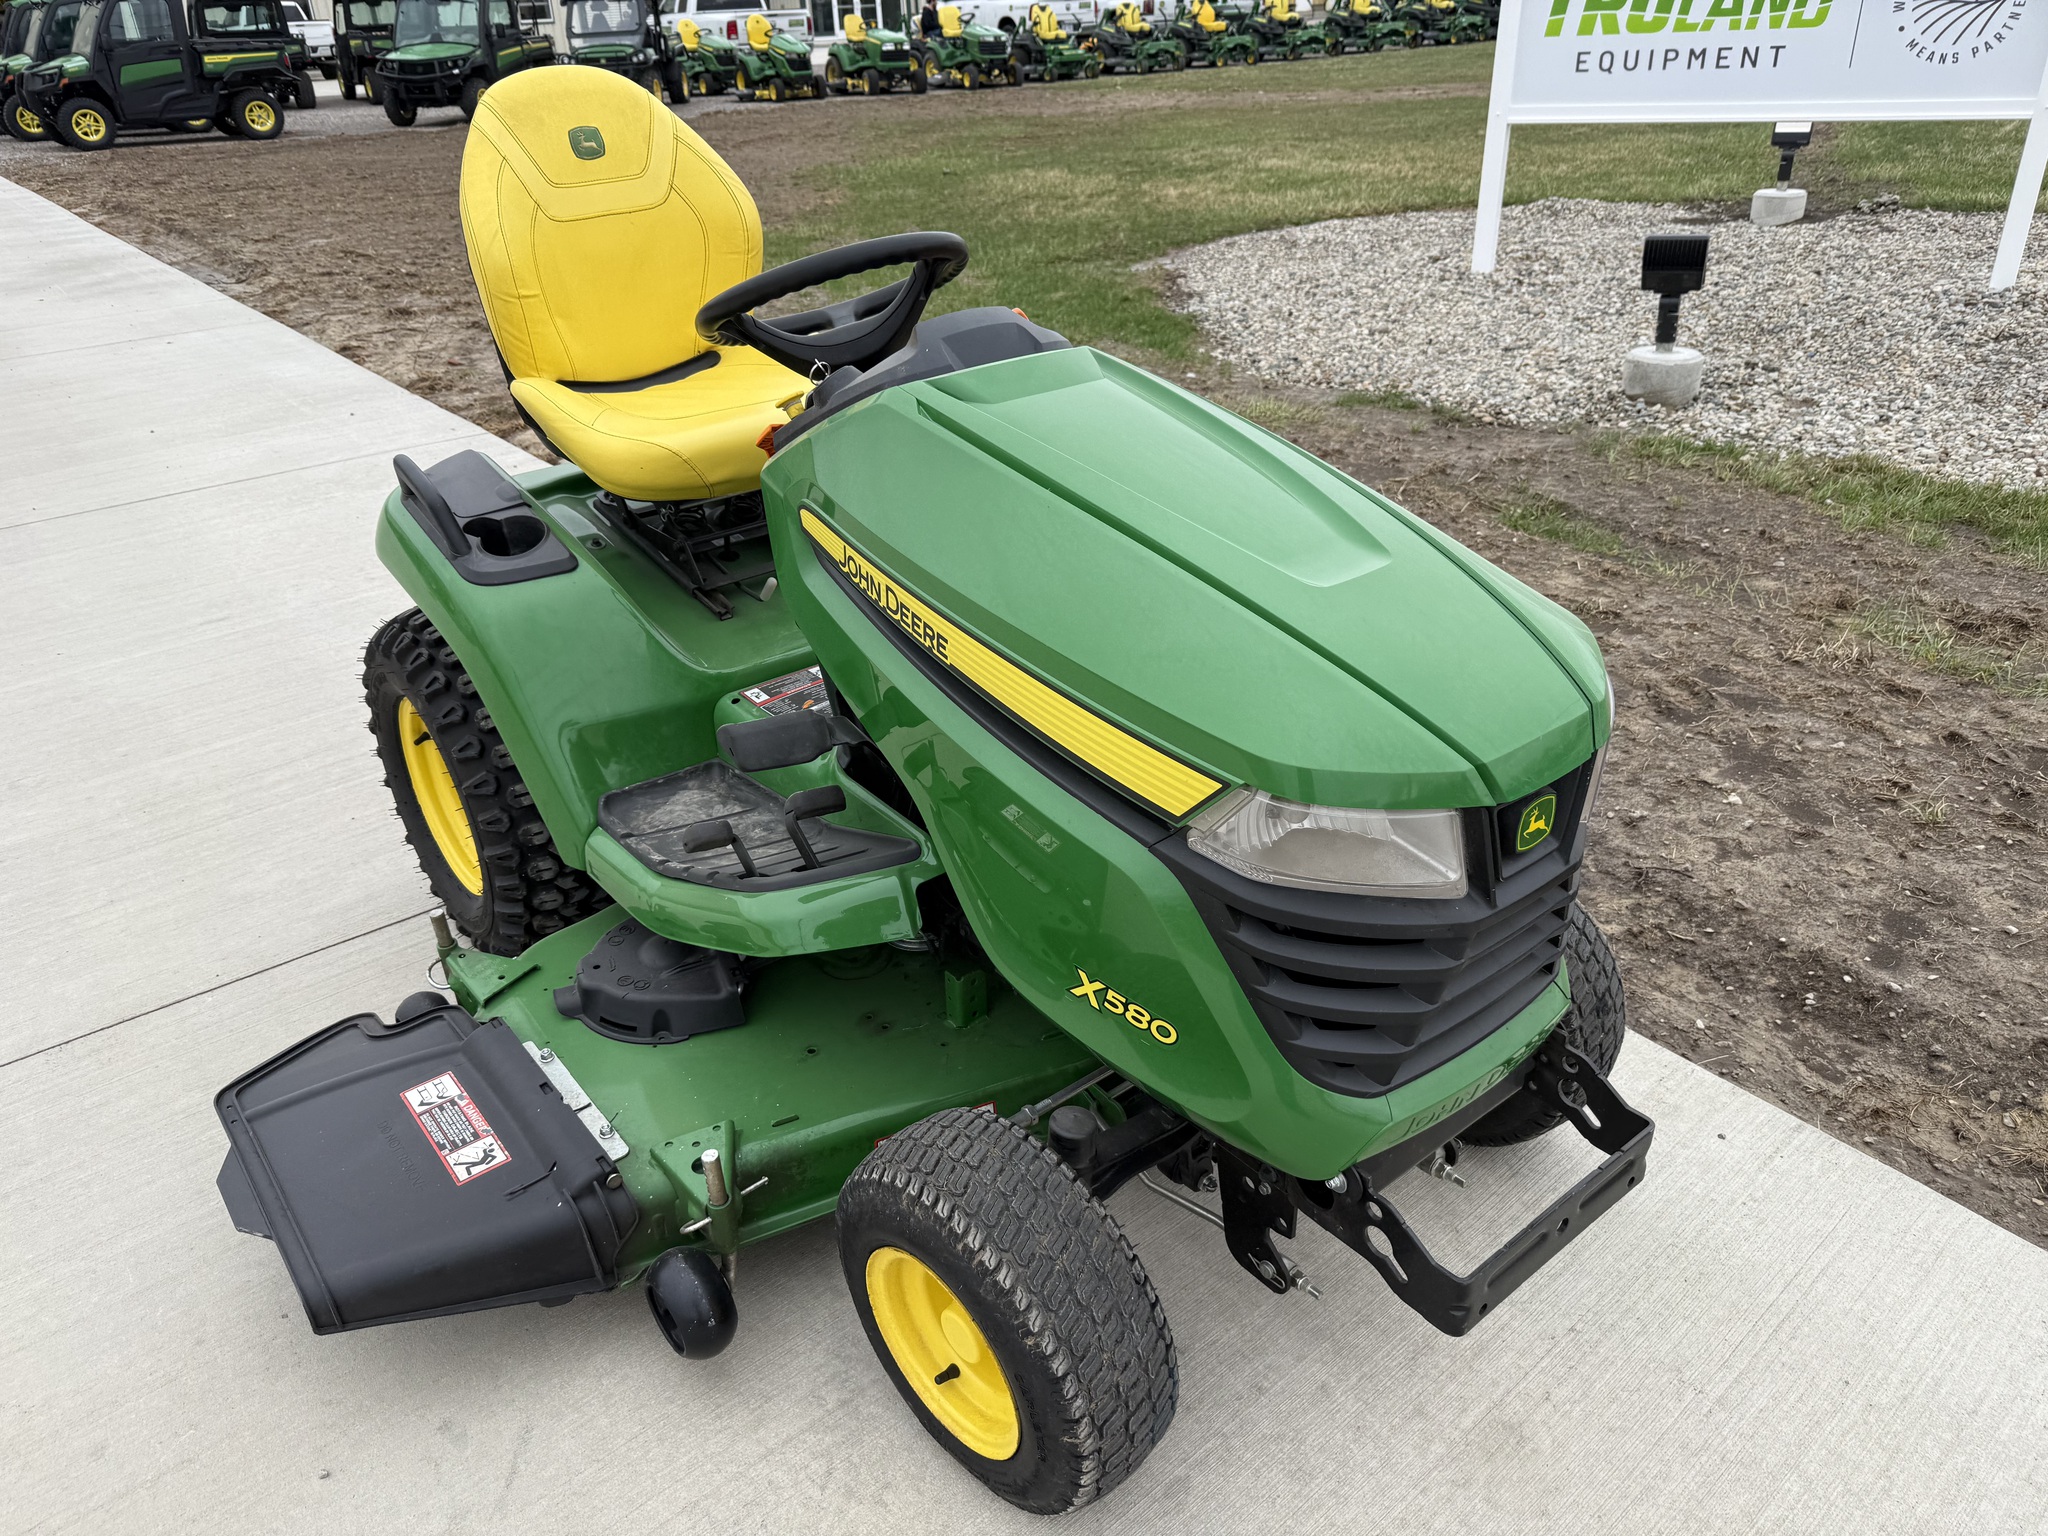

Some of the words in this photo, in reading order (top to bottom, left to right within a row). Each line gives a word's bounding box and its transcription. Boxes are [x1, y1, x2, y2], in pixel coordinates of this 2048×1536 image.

[1575, 45, 1786, 74] EQUIPMENT
[1905, 38, 1960, 65] MEANS
[838, 544, 882, 604] JOHN
[885, 584, 949, 662] DEERE
[1066, 966, 1179, 1045] X580
[463, 1104, 487, 1132] DANGER
